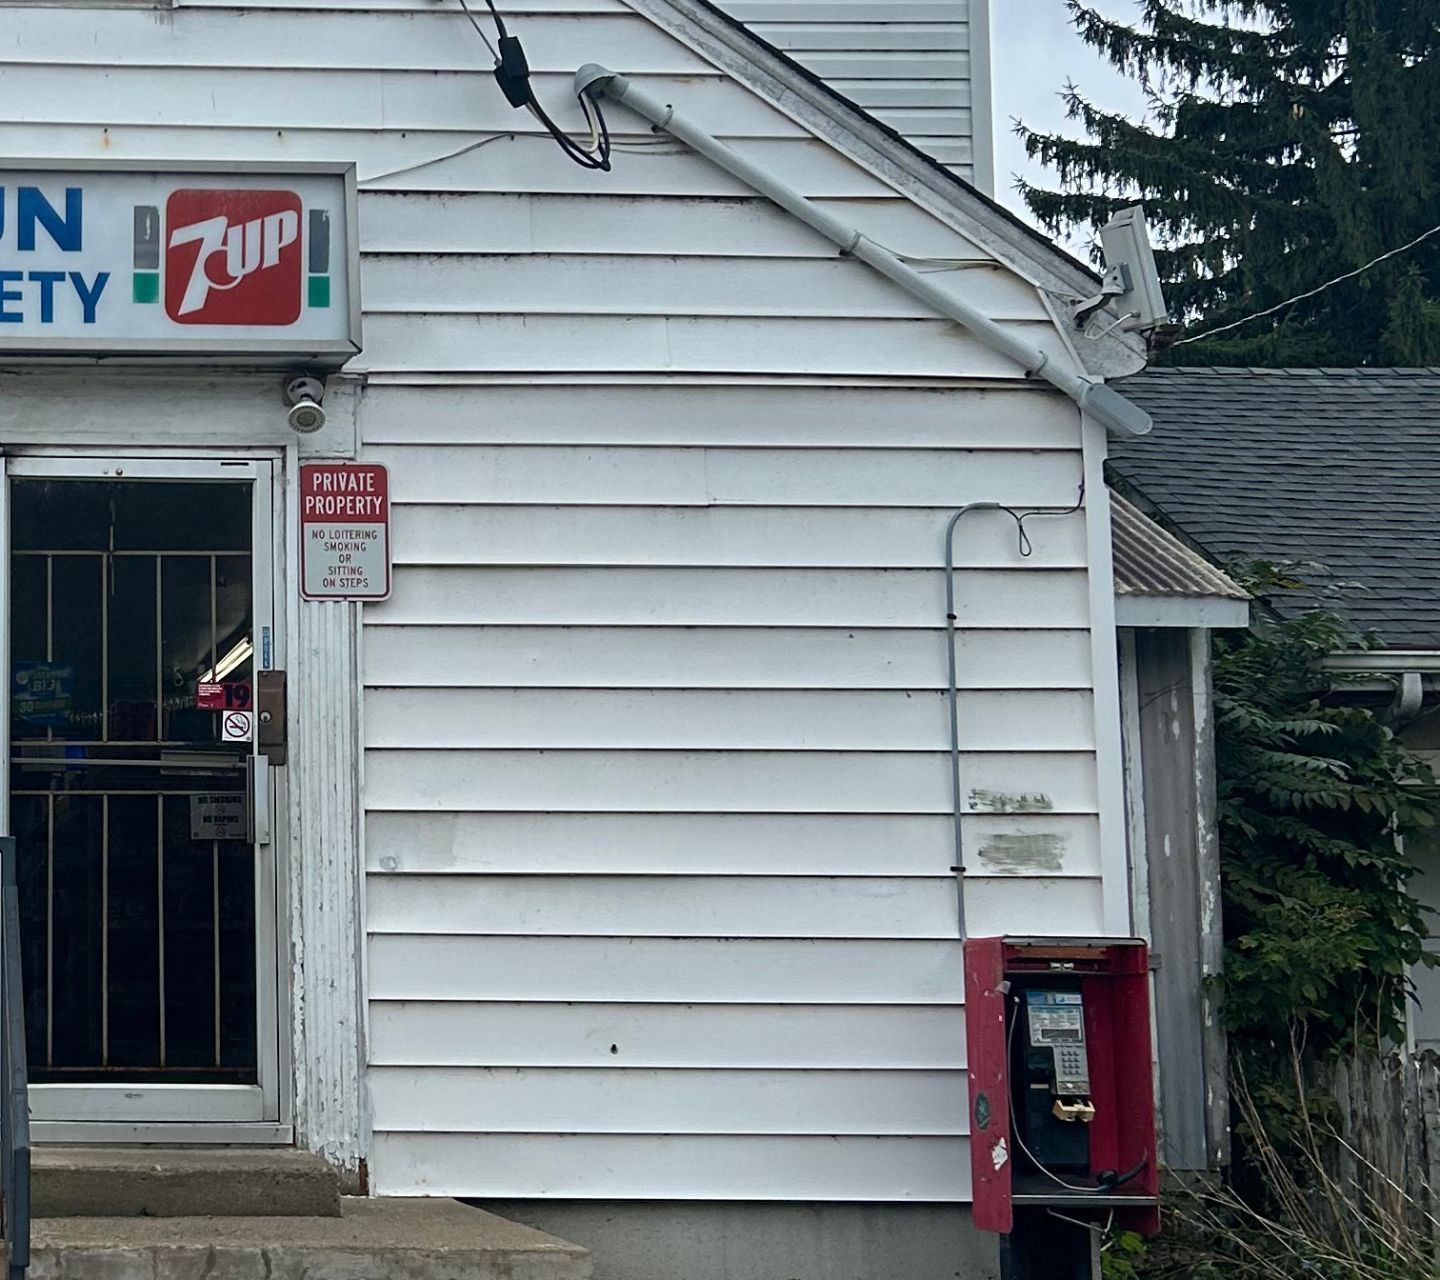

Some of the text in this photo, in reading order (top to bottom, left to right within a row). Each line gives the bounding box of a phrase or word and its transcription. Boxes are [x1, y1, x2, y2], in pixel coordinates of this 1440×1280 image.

[169, 209, 298, 316] 7UP
[313, 472, 375, 492] PRIVATE
[305, 495, 383, 515] PROPERTY
[312, 529, 378, 540] NO LOITERING
[324, 542, 367, 552] SMOKING
[338, 554, 352, 564] OR
[328, 566, 363, 576] SITTING
[322, 578, 369, 588] ON STEPS
[223, 683, 251, 708] 19
